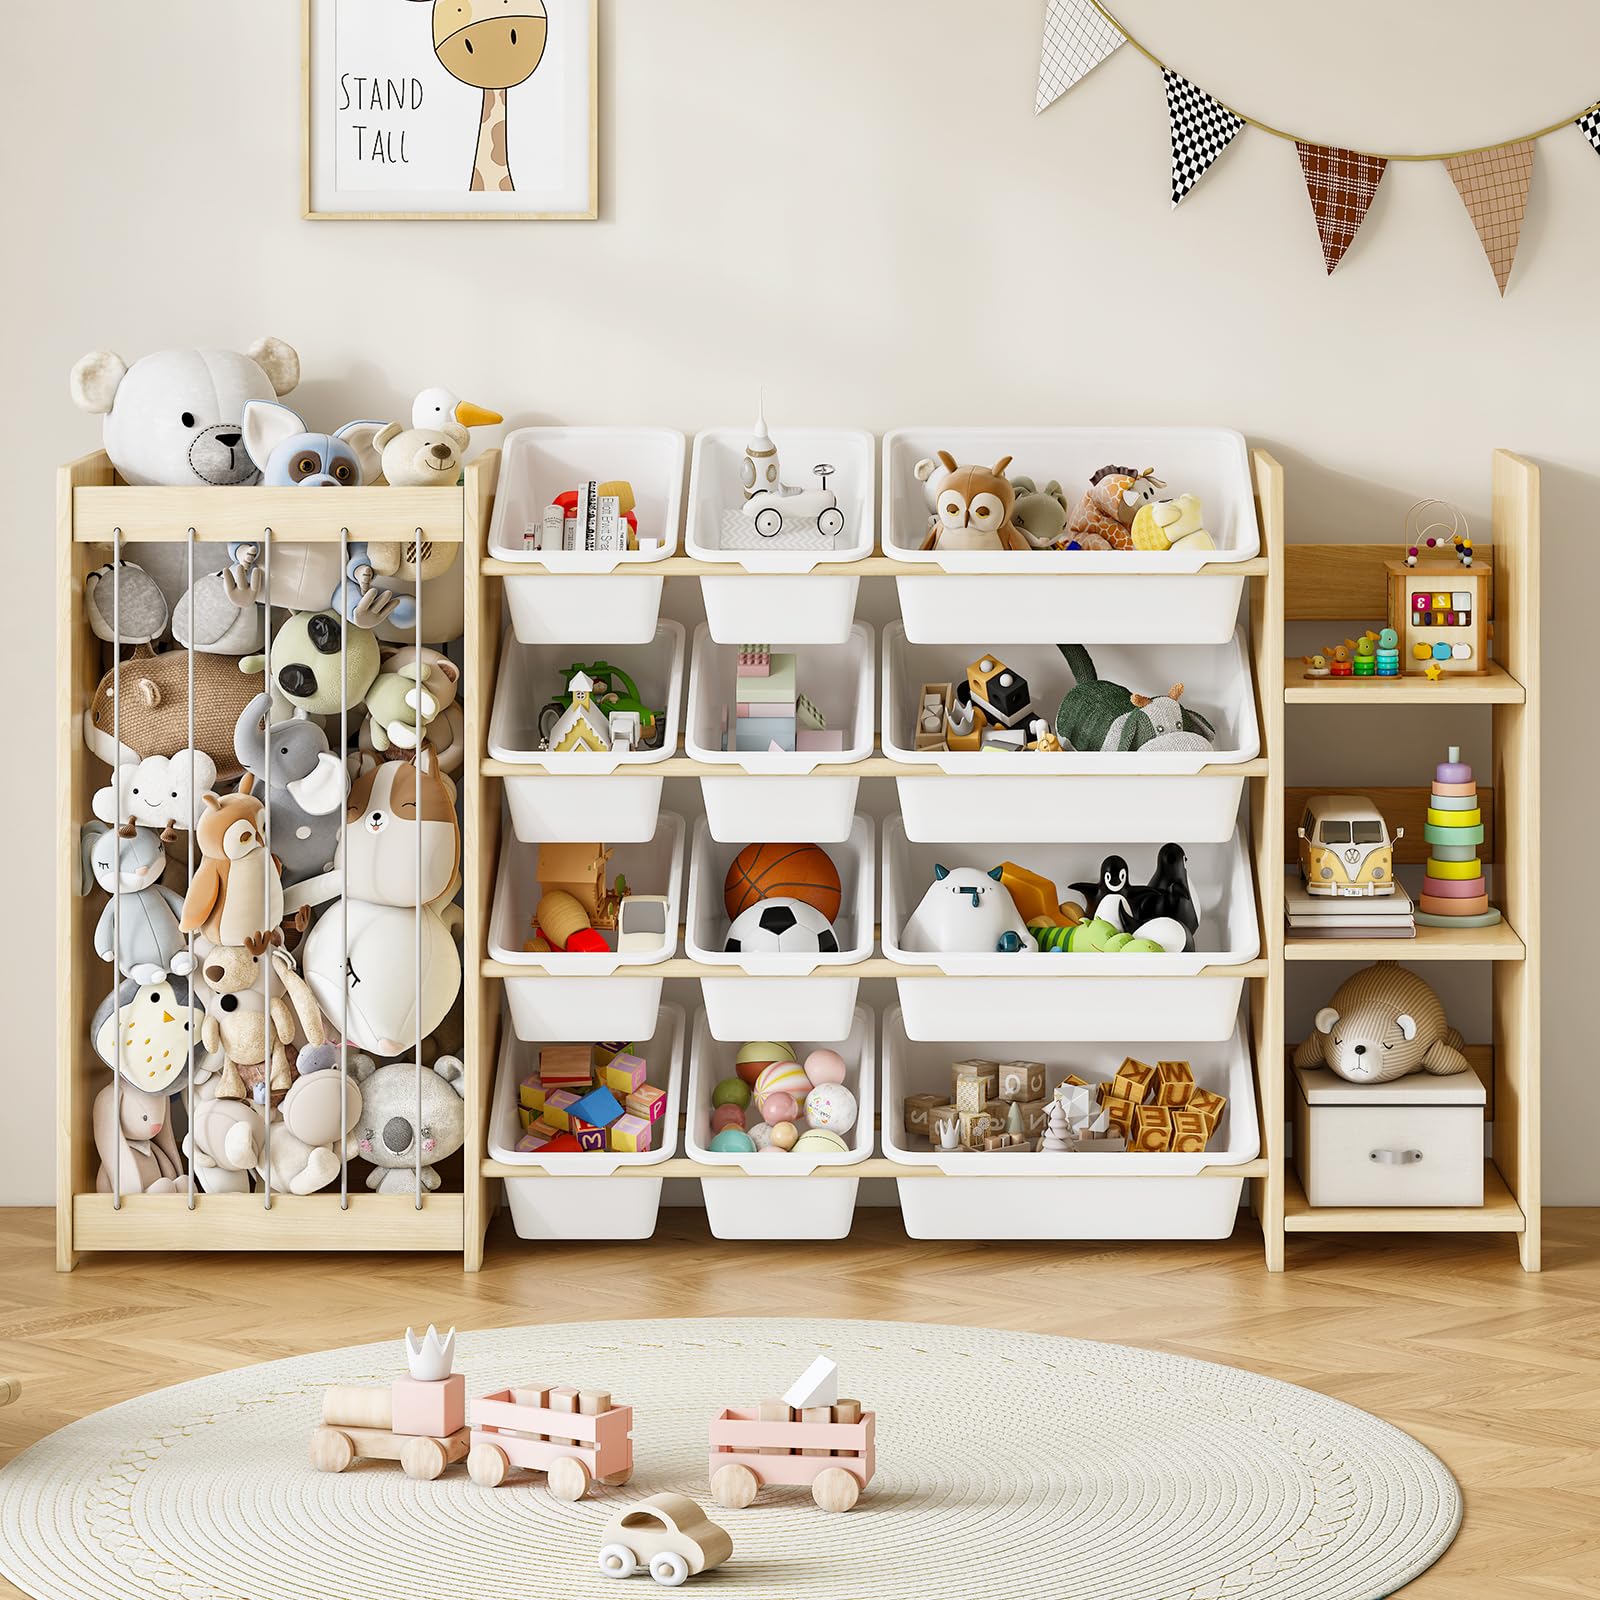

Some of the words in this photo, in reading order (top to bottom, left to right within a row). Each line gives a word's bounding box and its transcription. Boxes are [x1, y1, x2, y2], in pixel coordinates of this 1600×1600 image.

[339, 73, 424, 111] STAND
[352, 125, 409, 164] TALL
[582, 1133, 602, 1150] M
